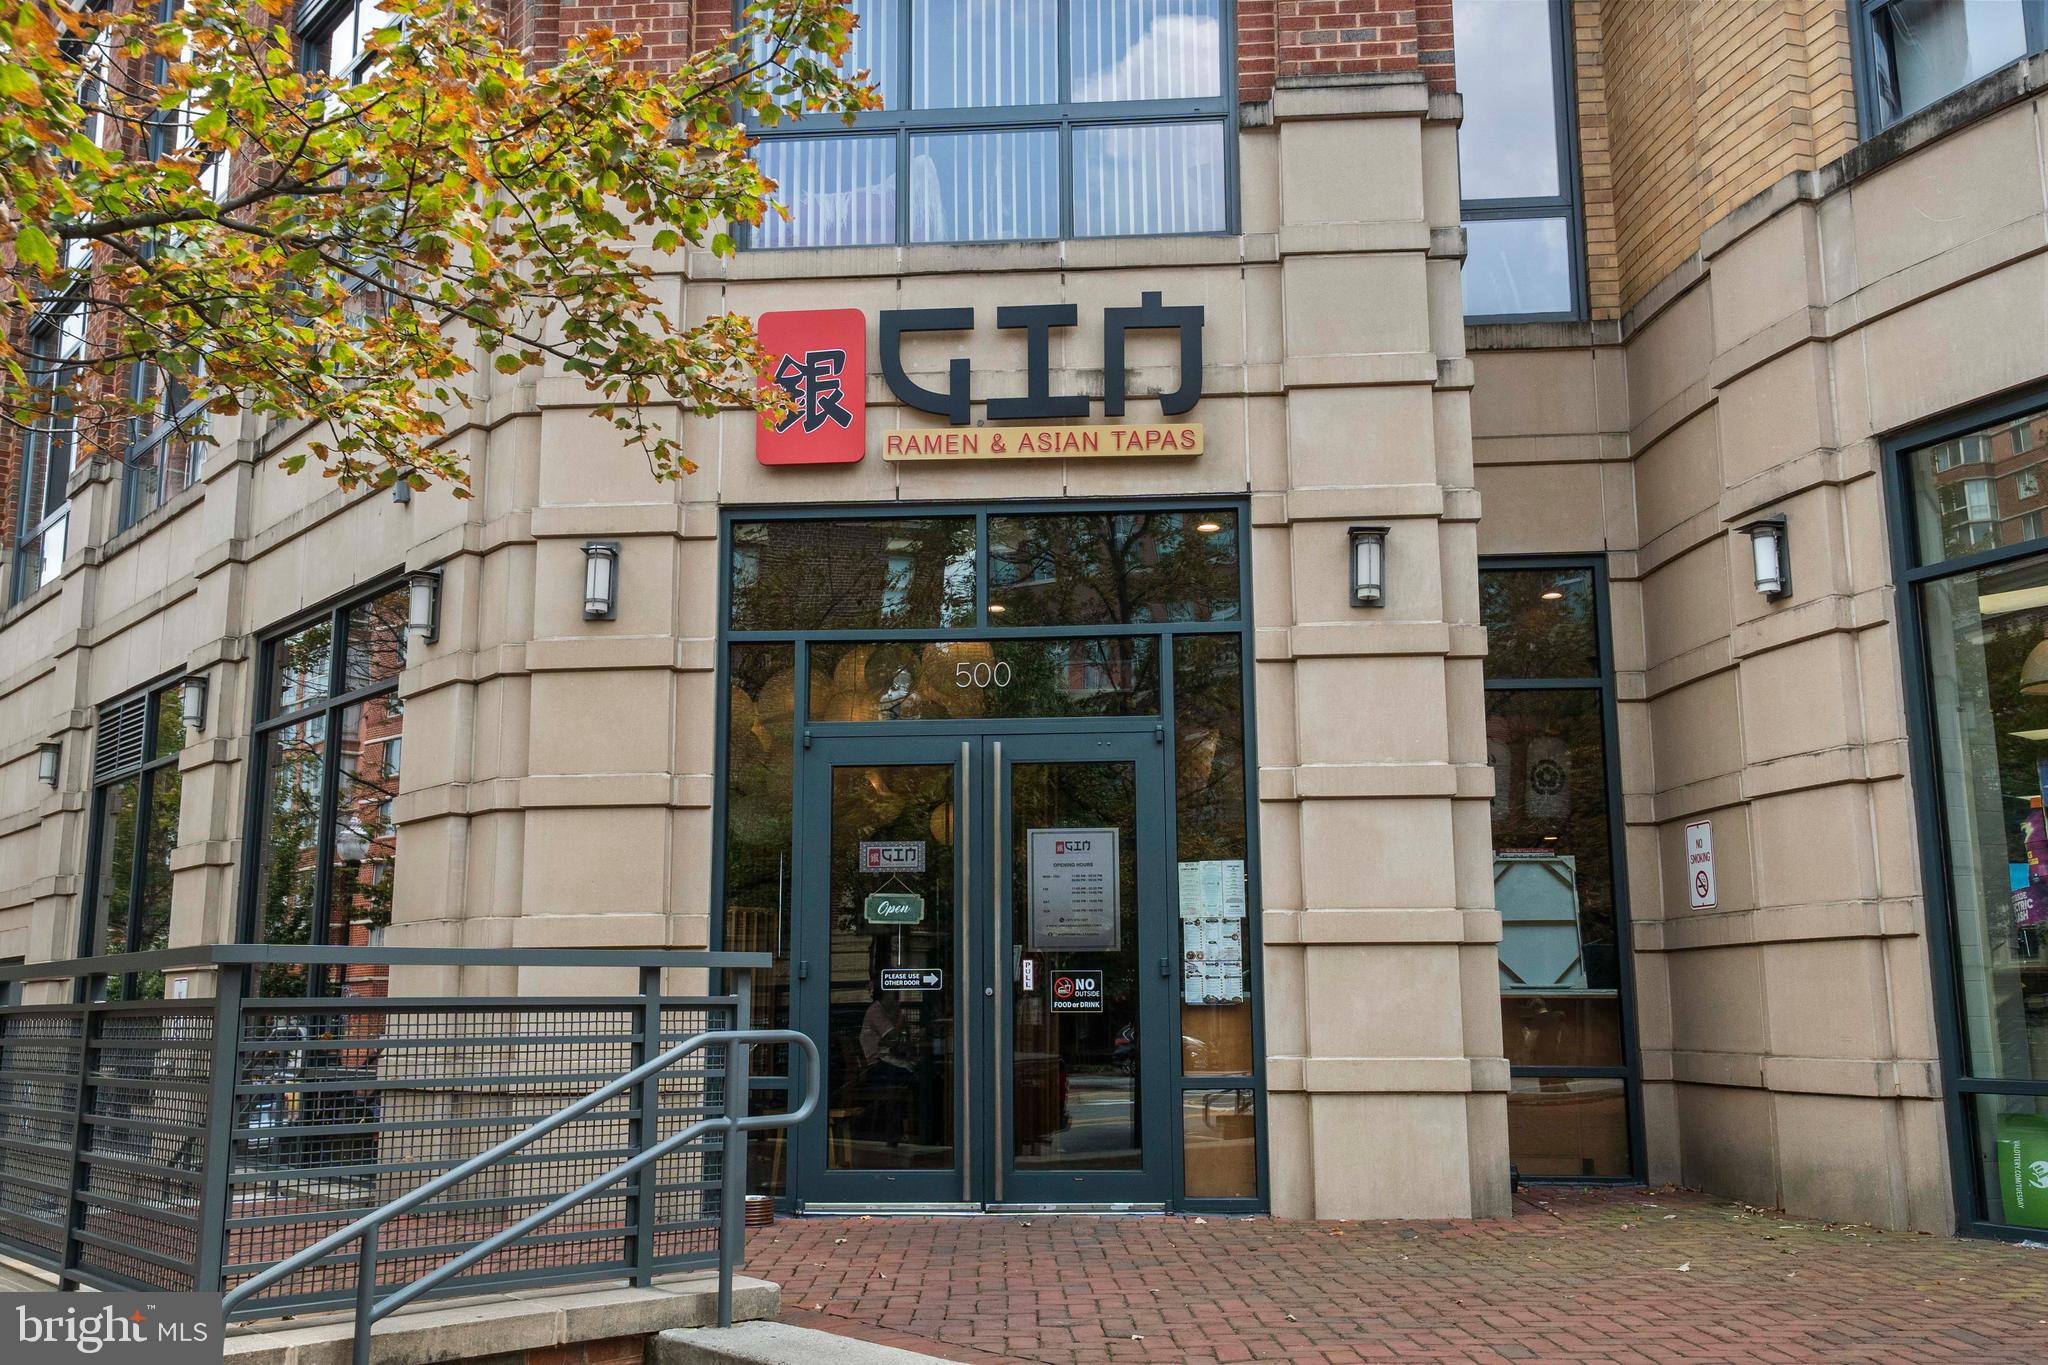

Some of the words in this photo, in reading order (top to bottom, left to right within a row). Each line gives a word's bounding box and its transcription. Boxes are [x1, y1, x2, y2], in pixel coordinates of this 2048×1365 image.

[887, 433, 979, 455] RAMEN
[990, 432, 1007, 453] &
[1018, 431, 1099, 453] ASIAN
[1111, 429, 1197, 450] TAPAS
[955, 661, 1011, 688] 500
[1696, 838, 1703, 848] NO
[1690, 852, 1711, 865] SMOKING
[877, 900, 911, 917] Open
[1075, 978, 1095, 990] NO
